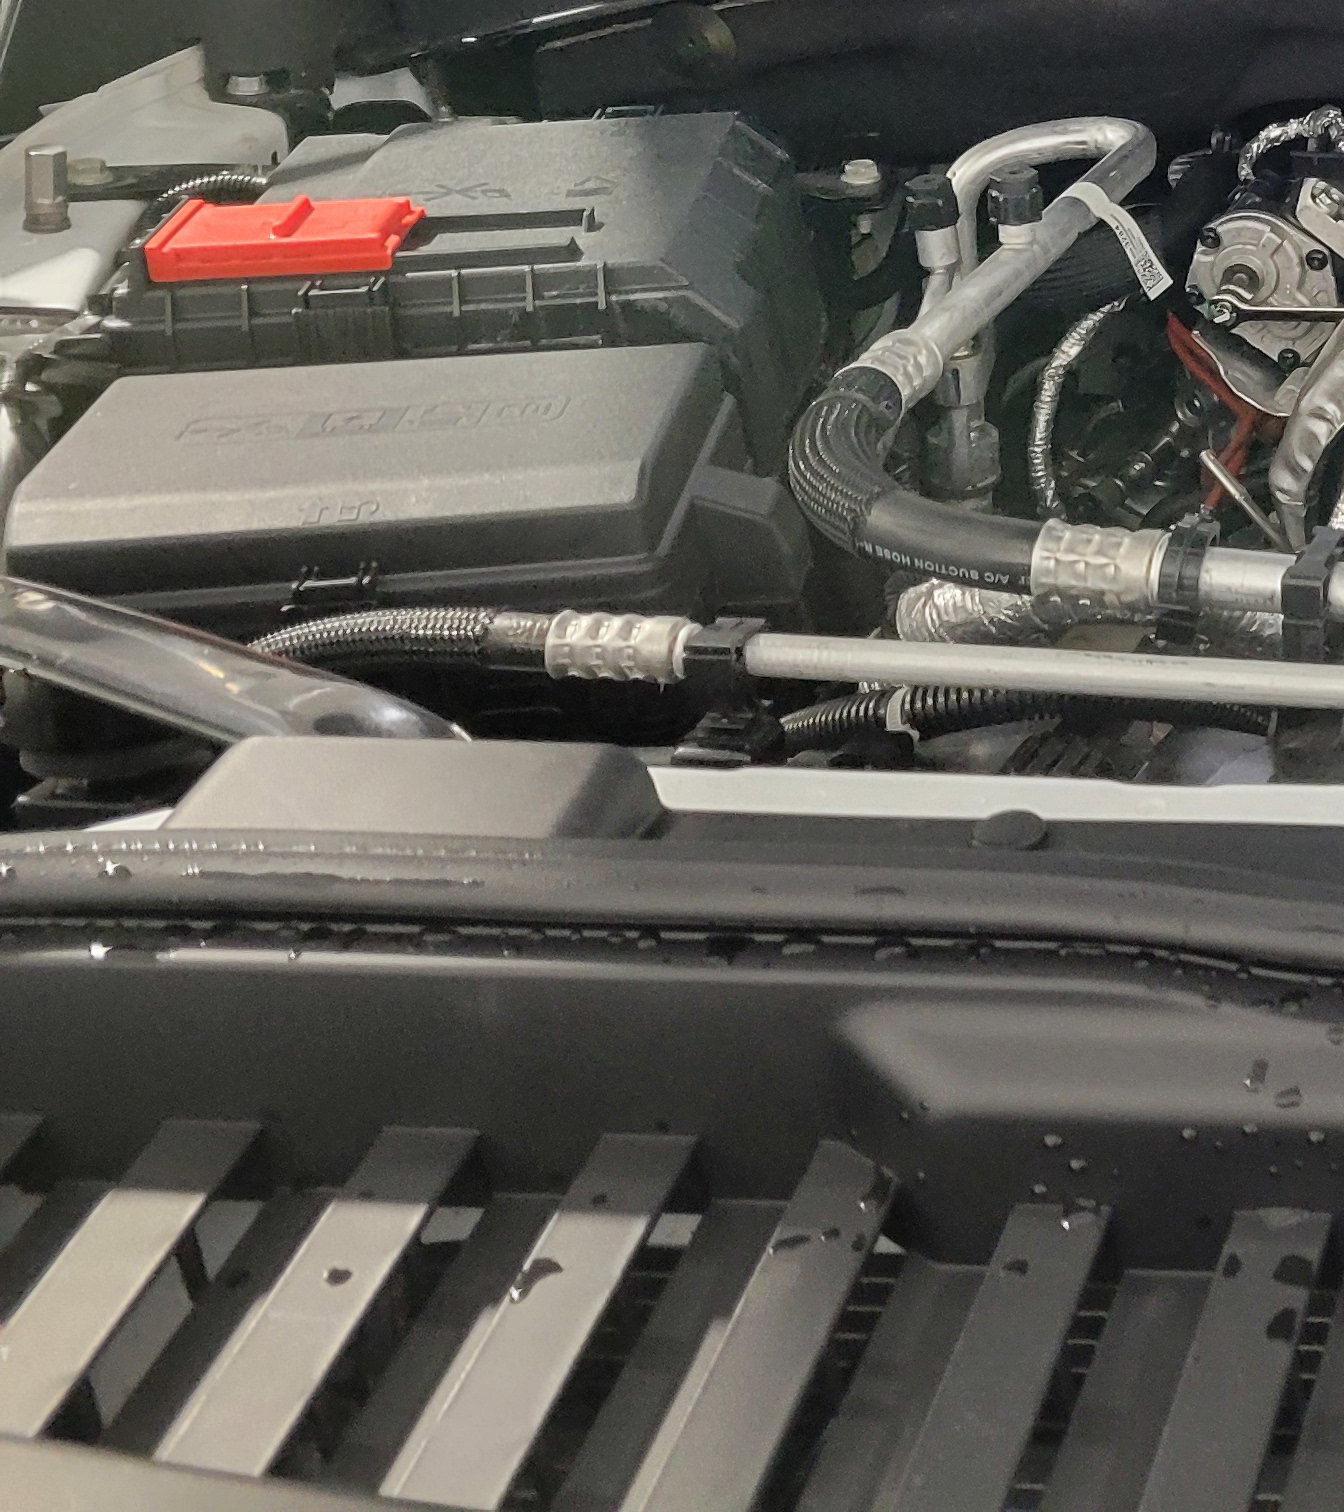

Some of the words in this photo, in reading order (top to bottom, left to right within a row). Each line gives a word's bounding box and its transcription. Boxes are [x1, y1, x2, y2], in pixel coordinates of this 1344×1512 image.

[875, 544, 910, 566] HOSE
[914, 557, 979, 580] SUCTION
[984, 571, 1010, 584] A/C
